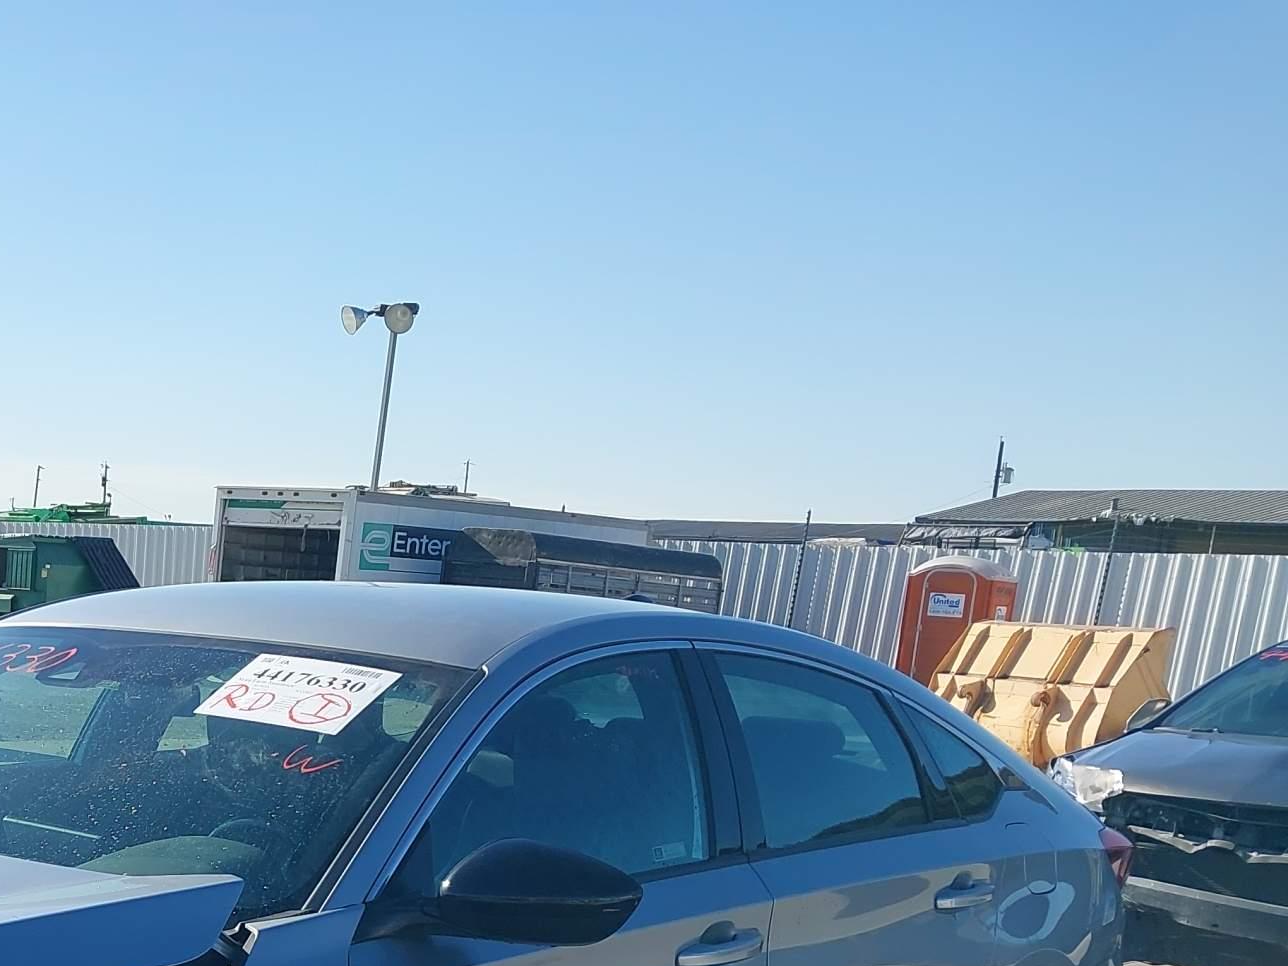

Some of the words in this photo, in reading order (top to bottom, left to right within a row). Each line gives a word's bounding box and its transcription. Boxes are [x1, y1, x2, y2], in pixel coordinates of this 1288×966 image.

[393, 531, 451, 556] Enter
[933, 597, 961, 606] United
[253, 668, 367, 693] 44176330
